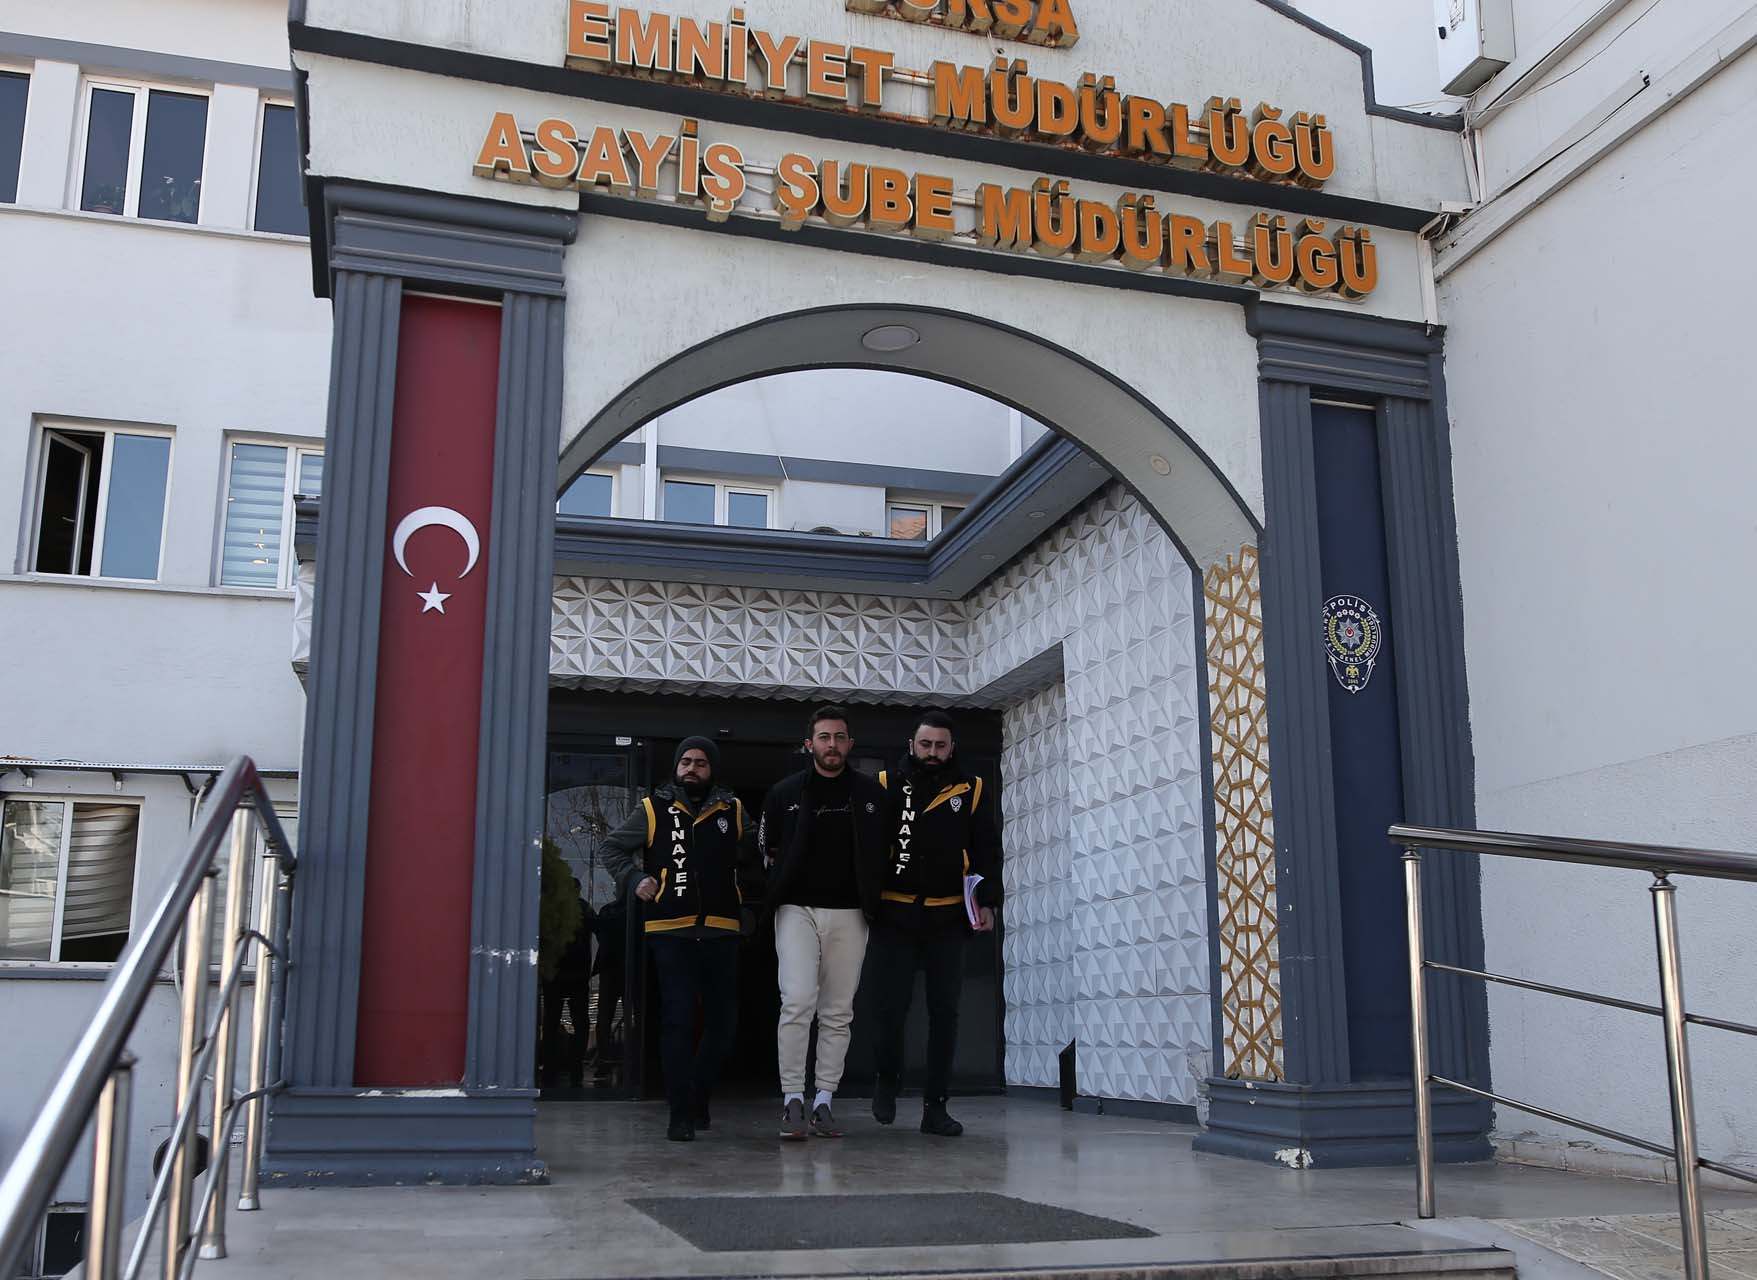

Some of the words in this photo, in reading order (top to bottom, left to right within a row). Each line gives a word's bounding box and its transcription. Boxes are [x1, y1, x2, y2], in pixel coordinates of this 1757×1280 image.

[567, 0, 894, 107] EMNİYET
[930, 56, 1335, 186] MÜDÜRLÜĞÜ
[473, 112, 745, 217] ASAYİŞ
[776, 153, 954, 231] ŞUBE
[977, 177, 1378, 298] MÜDÜRLÜĞÜ
